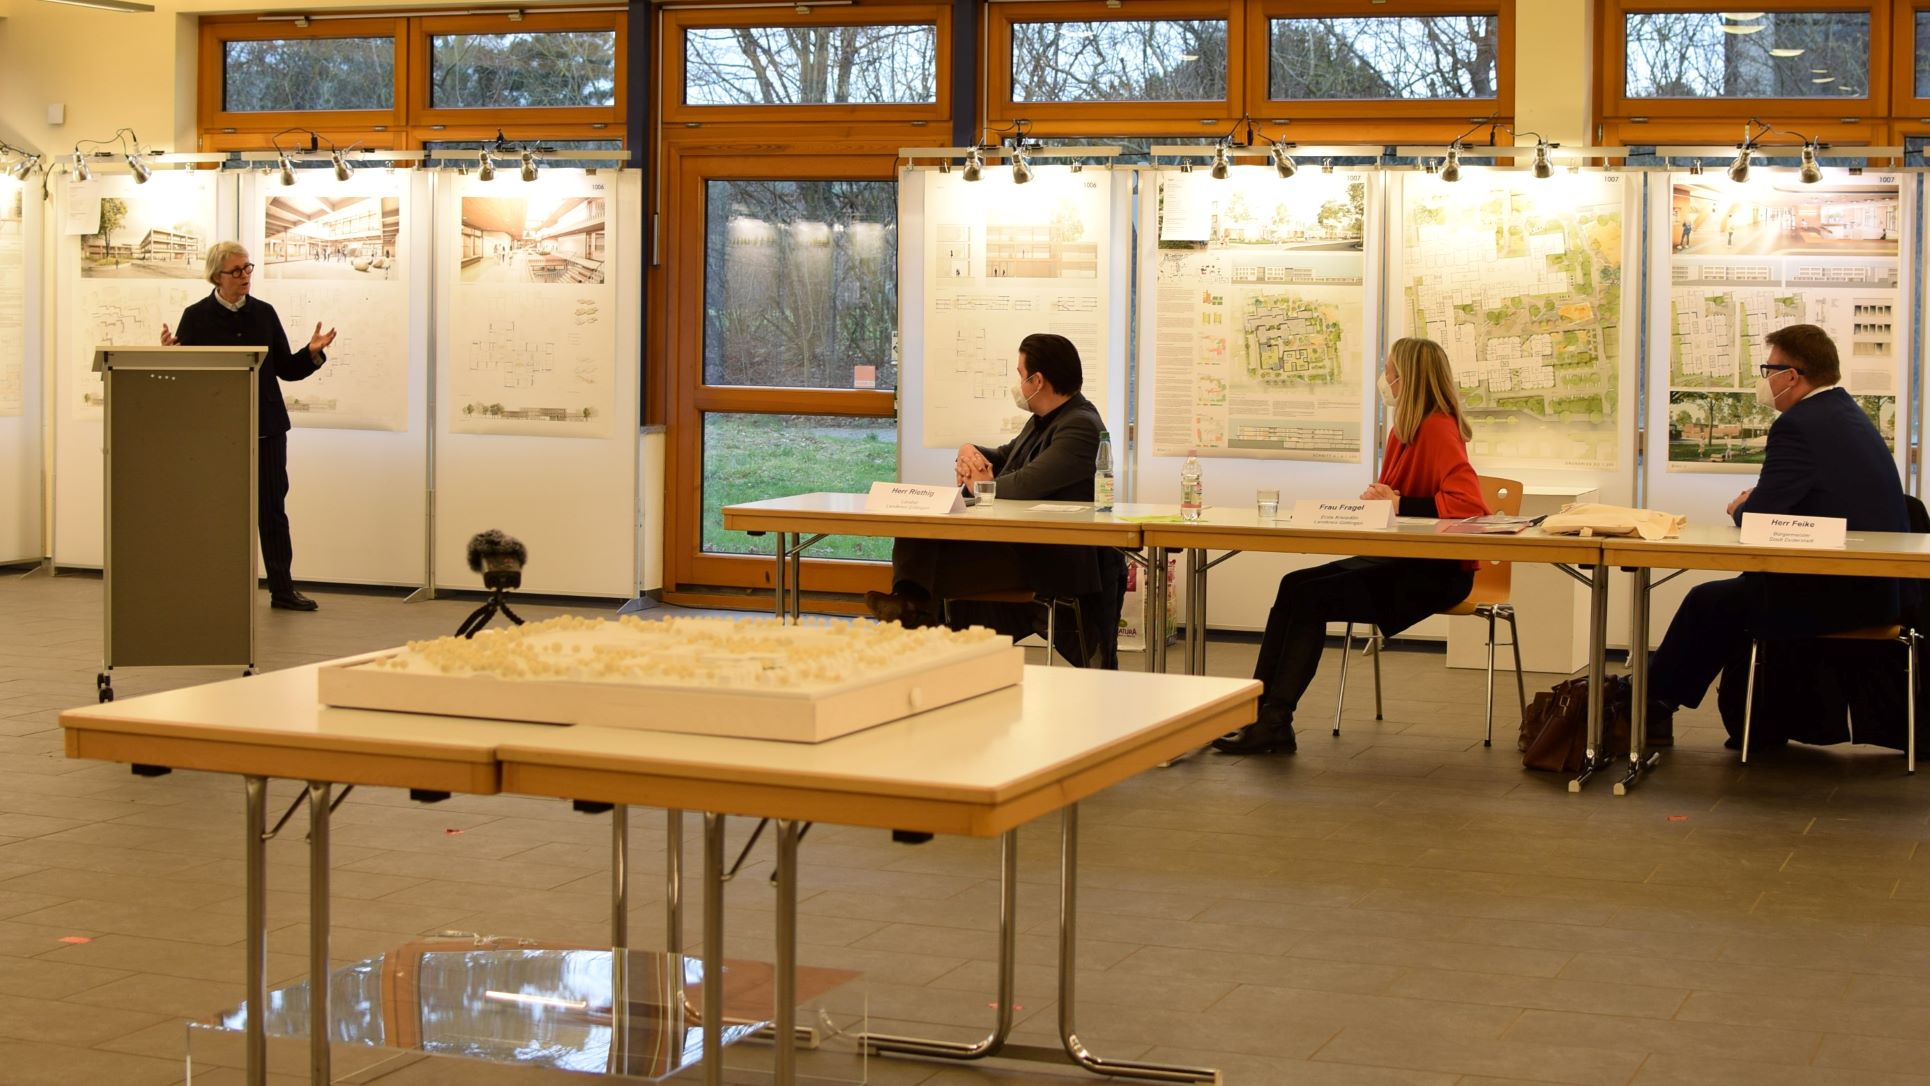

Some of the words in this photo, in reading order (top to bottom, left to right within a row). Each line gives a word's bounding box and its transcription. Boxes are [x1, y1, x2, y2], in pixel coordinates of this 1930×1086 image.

[909, 488, 935, 497] Riethig
[1792, 520, 1815, 528] Feike
[1118, 628, 1137, 636] ATURA
